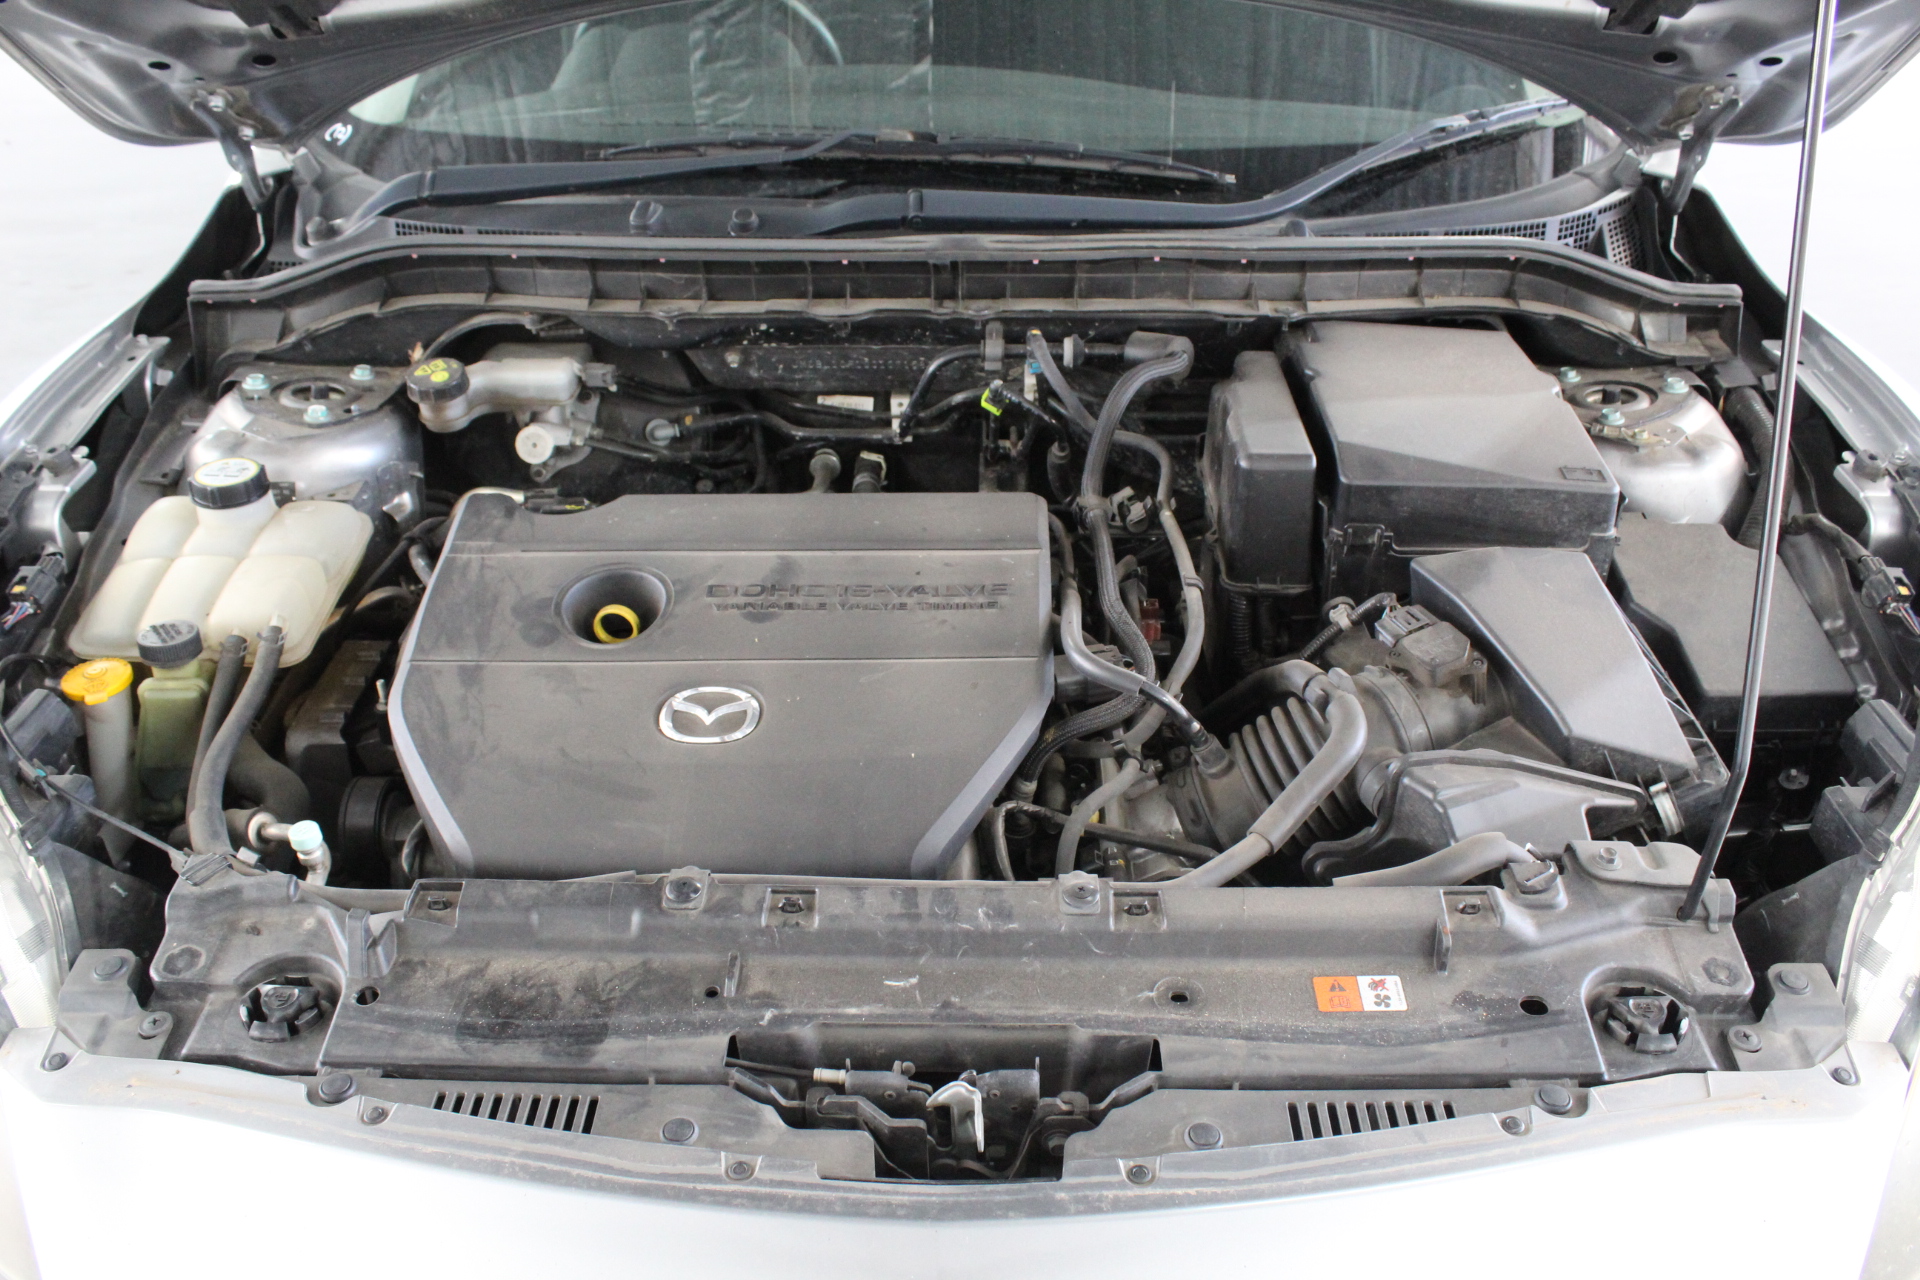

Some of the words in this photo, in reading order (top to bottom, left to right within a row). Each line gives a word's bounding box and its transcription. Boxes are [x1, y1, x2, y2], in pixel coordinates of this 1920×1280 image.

[706, 583, 830, 598] DOHC
[713, 601, 828, 612] VARIABLE
[836, 601, 909, 612] VALVE
[915, 601, 999, 612] TIMING
